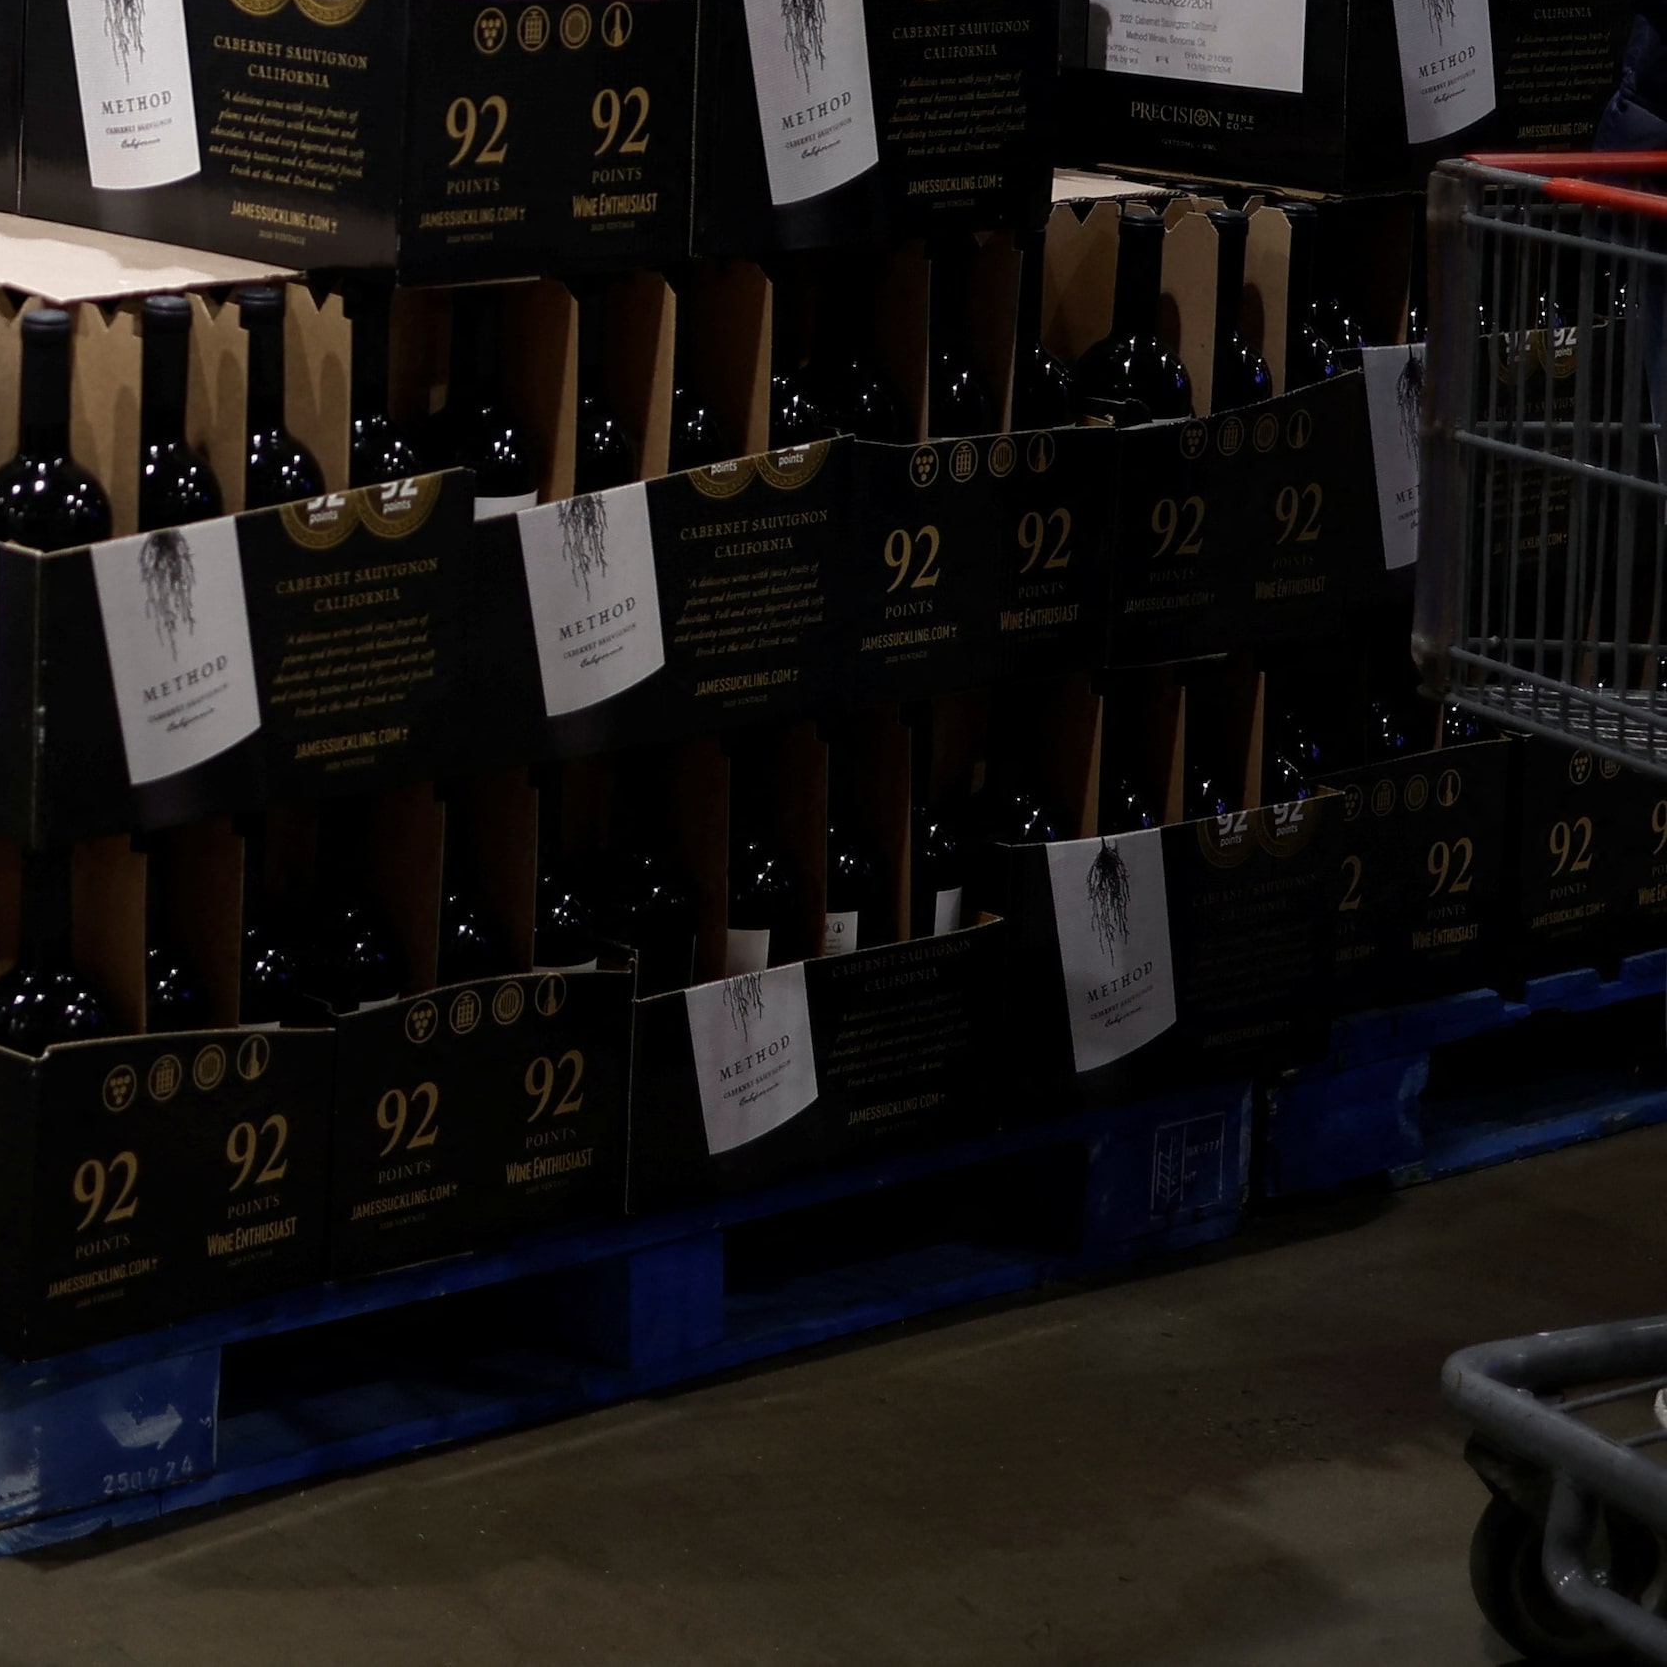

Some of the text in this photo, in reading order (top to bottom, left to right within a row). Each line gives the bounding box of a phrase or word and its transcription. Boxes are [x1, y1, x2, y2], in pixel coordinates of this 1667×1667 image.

[1417, 45, 1477, 79] METHOD
[445, 95, 509, 168] 92
[591, 87, 650, 157] 92
[781, 91, 853, 132] METHOD
[1130, 101, 1221, 129] PRECISION
[446, 176, 500, 194] POINTS
[591, 167, 643, 183] POINTS
[599, 192, 658, 216] ENTHUSIAST
[883, 524, 941, 594] 92
[557, 596, 636, 641] METHOD
[141, 653, 229, 706] METHOD
[718, 1031, 791, 1083] METHOD
[225, 1114, 289, 1193] 92
[72, 1151, 139, 1231] 92
